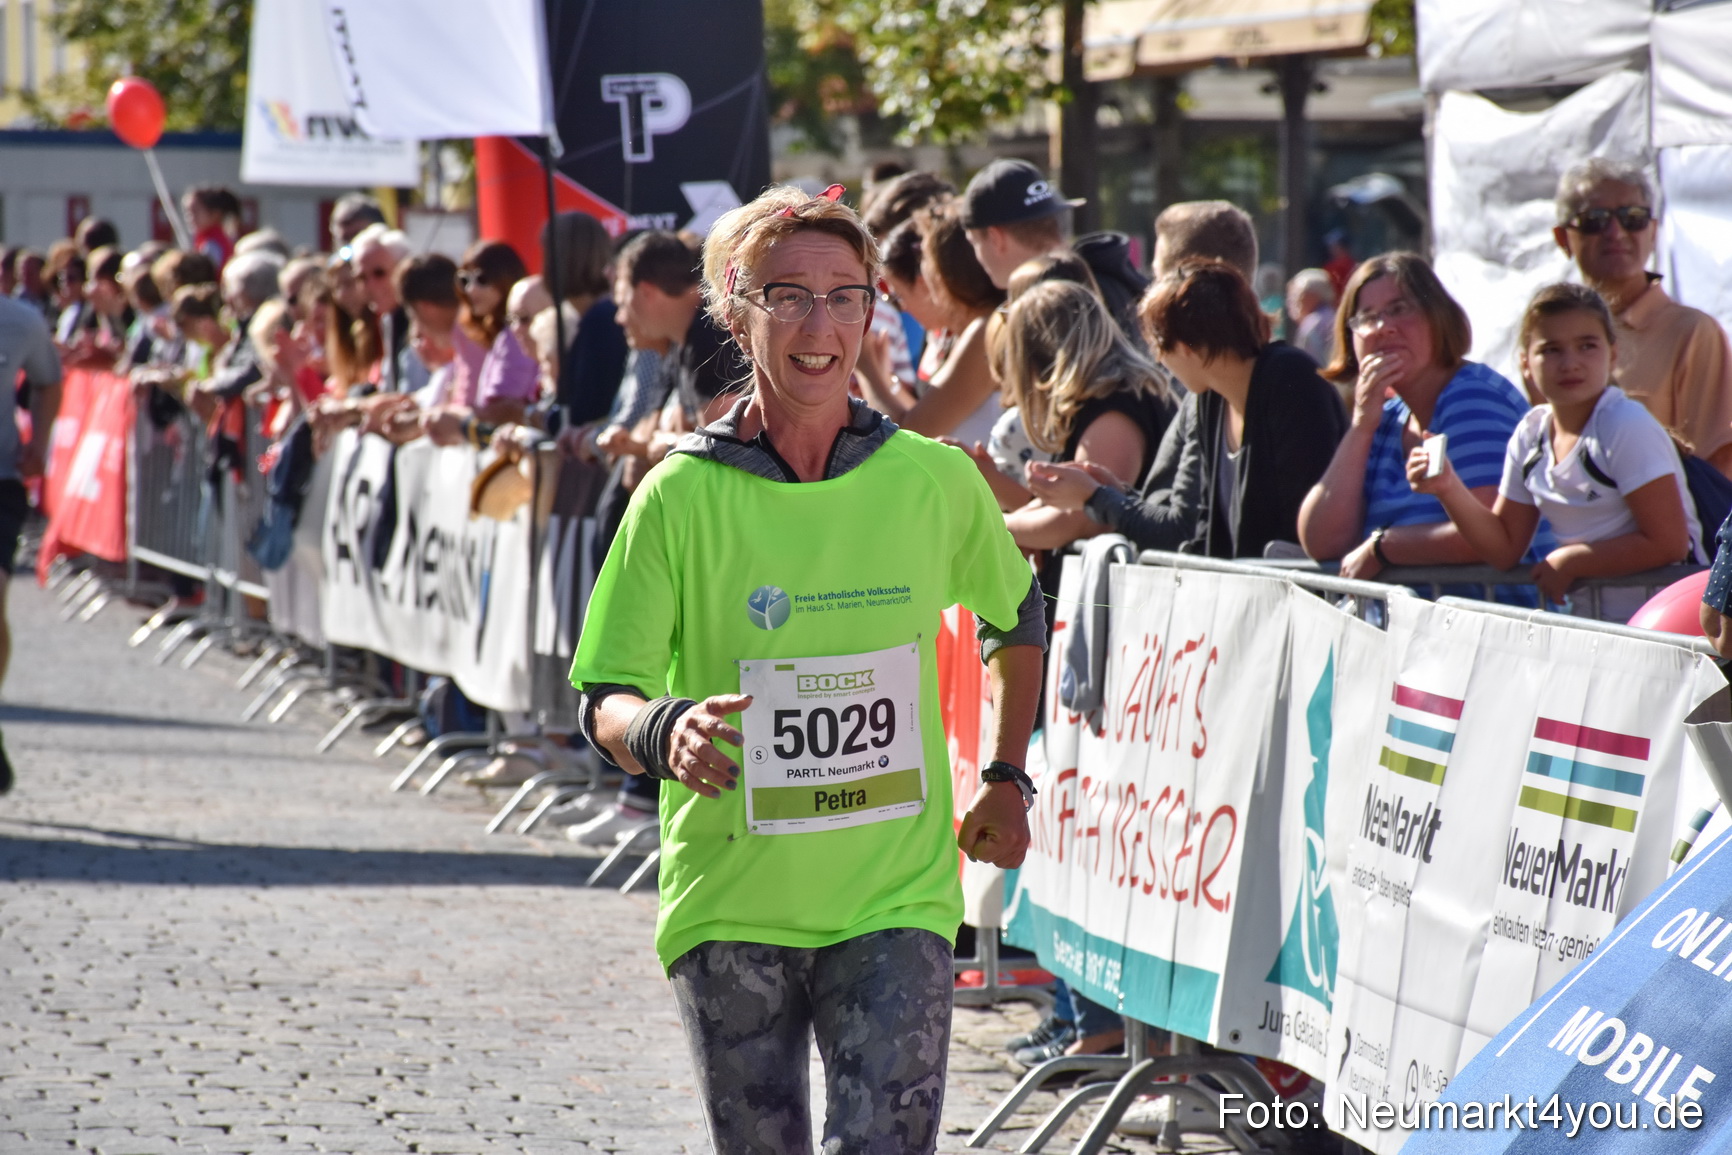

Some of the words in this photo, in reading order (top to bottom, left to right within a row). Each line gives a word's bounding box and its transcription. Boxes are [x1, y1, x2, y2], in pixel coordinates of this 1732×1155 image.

[794, 593, 816, 603] Freie
[818, 589, 866, 600] katholische
[868, 584, 911, 596] Volksschule
[795, 603, 805, 613] im
[806, 601, 825, 612] Haus
[826, 600, 836, 611] St.
[837, 598, 865, 609] Marien,
[797, 669, 875, 692] BOCK
[823, 691, 832, 699] by
[833, 689, 852, 697] smart
[852, 686, 876, 696] concepts
[773, 697, 896, 760] 5029
[755, 750, 763, 761] S
[786, 768, 826, 779] PARTL
[827, 760, 875, 776] Neumarkt
[814, 788, 867, 813] Petra
[1493, 910, 1530, 945] einkaufen
[1651, 907, 1732, 983] ONLI
[1257, 1001, 1292, 1037] Jura
[1547, 1005, 1717, 1121] MOBILE
